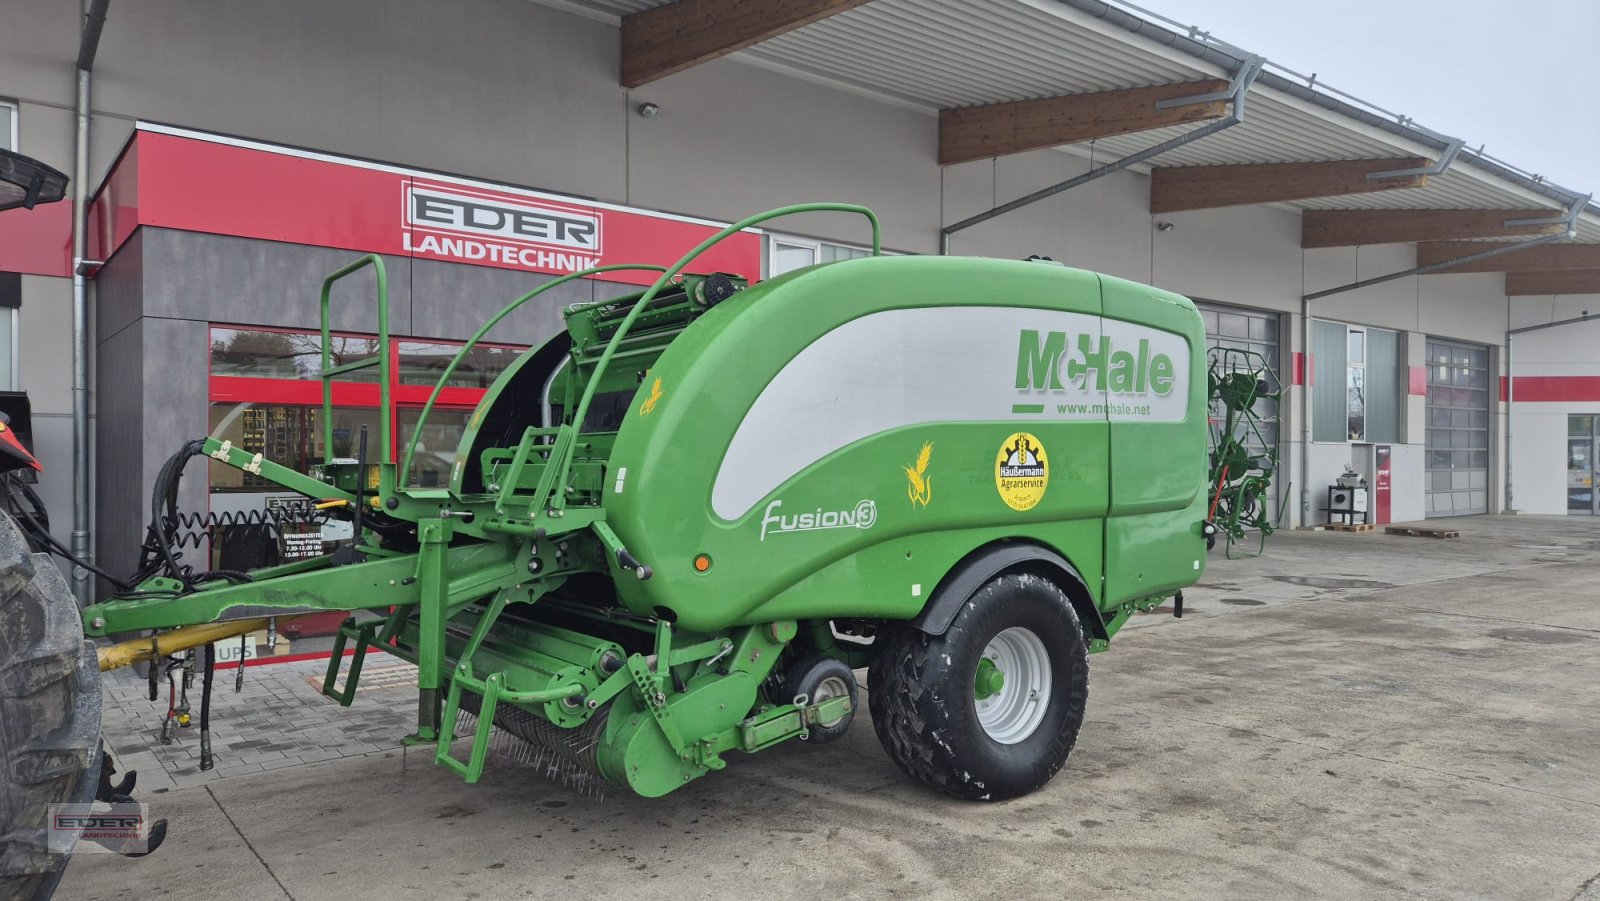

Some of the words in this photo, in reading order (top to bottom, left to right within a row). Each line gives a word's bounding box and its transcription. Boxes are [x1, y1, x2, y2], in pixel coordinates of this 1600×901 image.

[412, 194, 595, 245] EDER
[403, 233, 602, 275] LANDTECHNIK
[1015, 329, 1175, 395] McHale
[1057, 404, 1151, 415] www.mchale.net
[1000, 466, 1044, 477] Häußermann
[1001, 479, 1044, 491] Agrarservice
[218, 645, 253, 660] UPS
